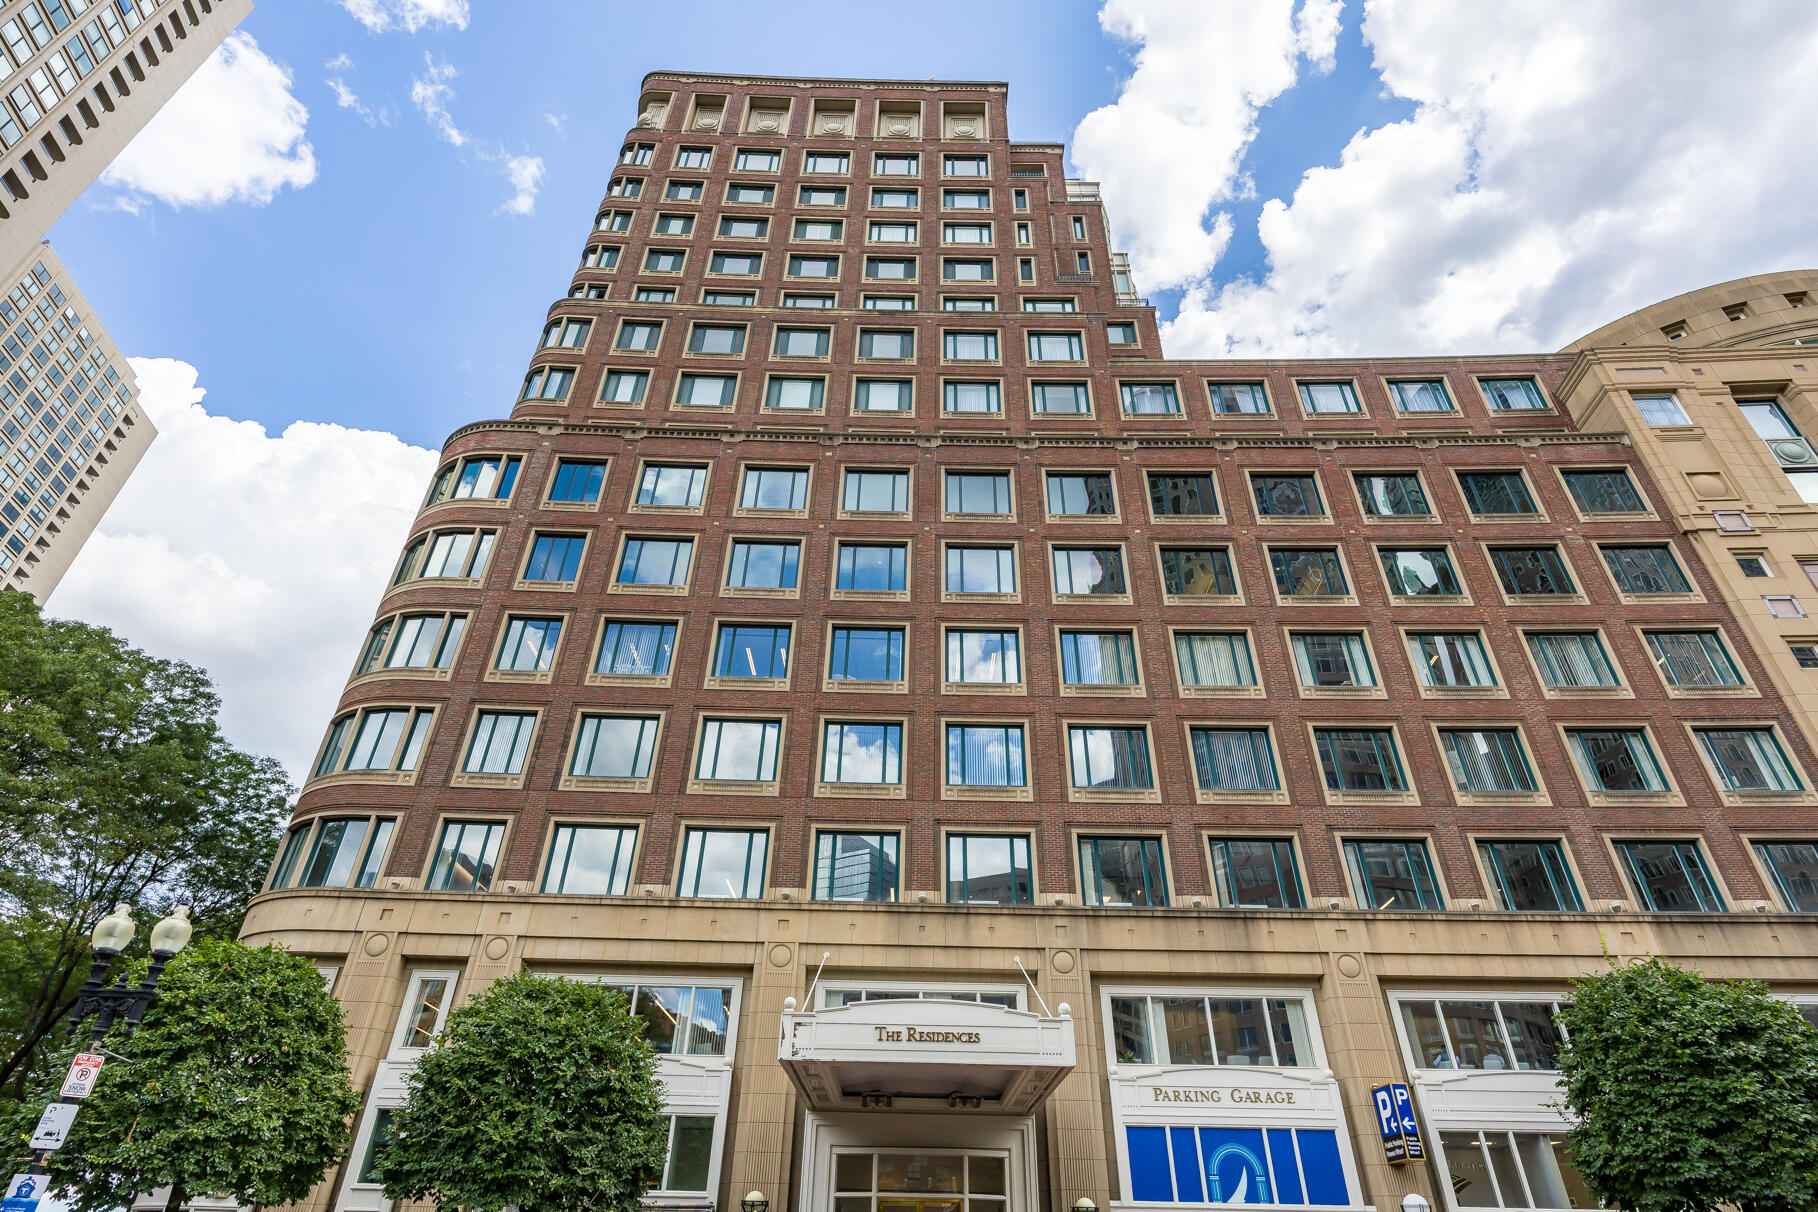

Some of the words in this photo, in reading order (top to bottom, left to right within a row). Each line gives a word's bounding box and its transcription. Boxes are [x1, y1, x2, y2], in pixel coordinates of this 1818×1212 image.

[906, 1027, 981, 1043] RESIDENCES
[1153, 1087, 1221, 1103] PARKING
[1230, 1088, 1296, 1104] GARAGE
[1395, 1089, 1408, 1105] P
[1376, 1091, 1392, 1134] P
